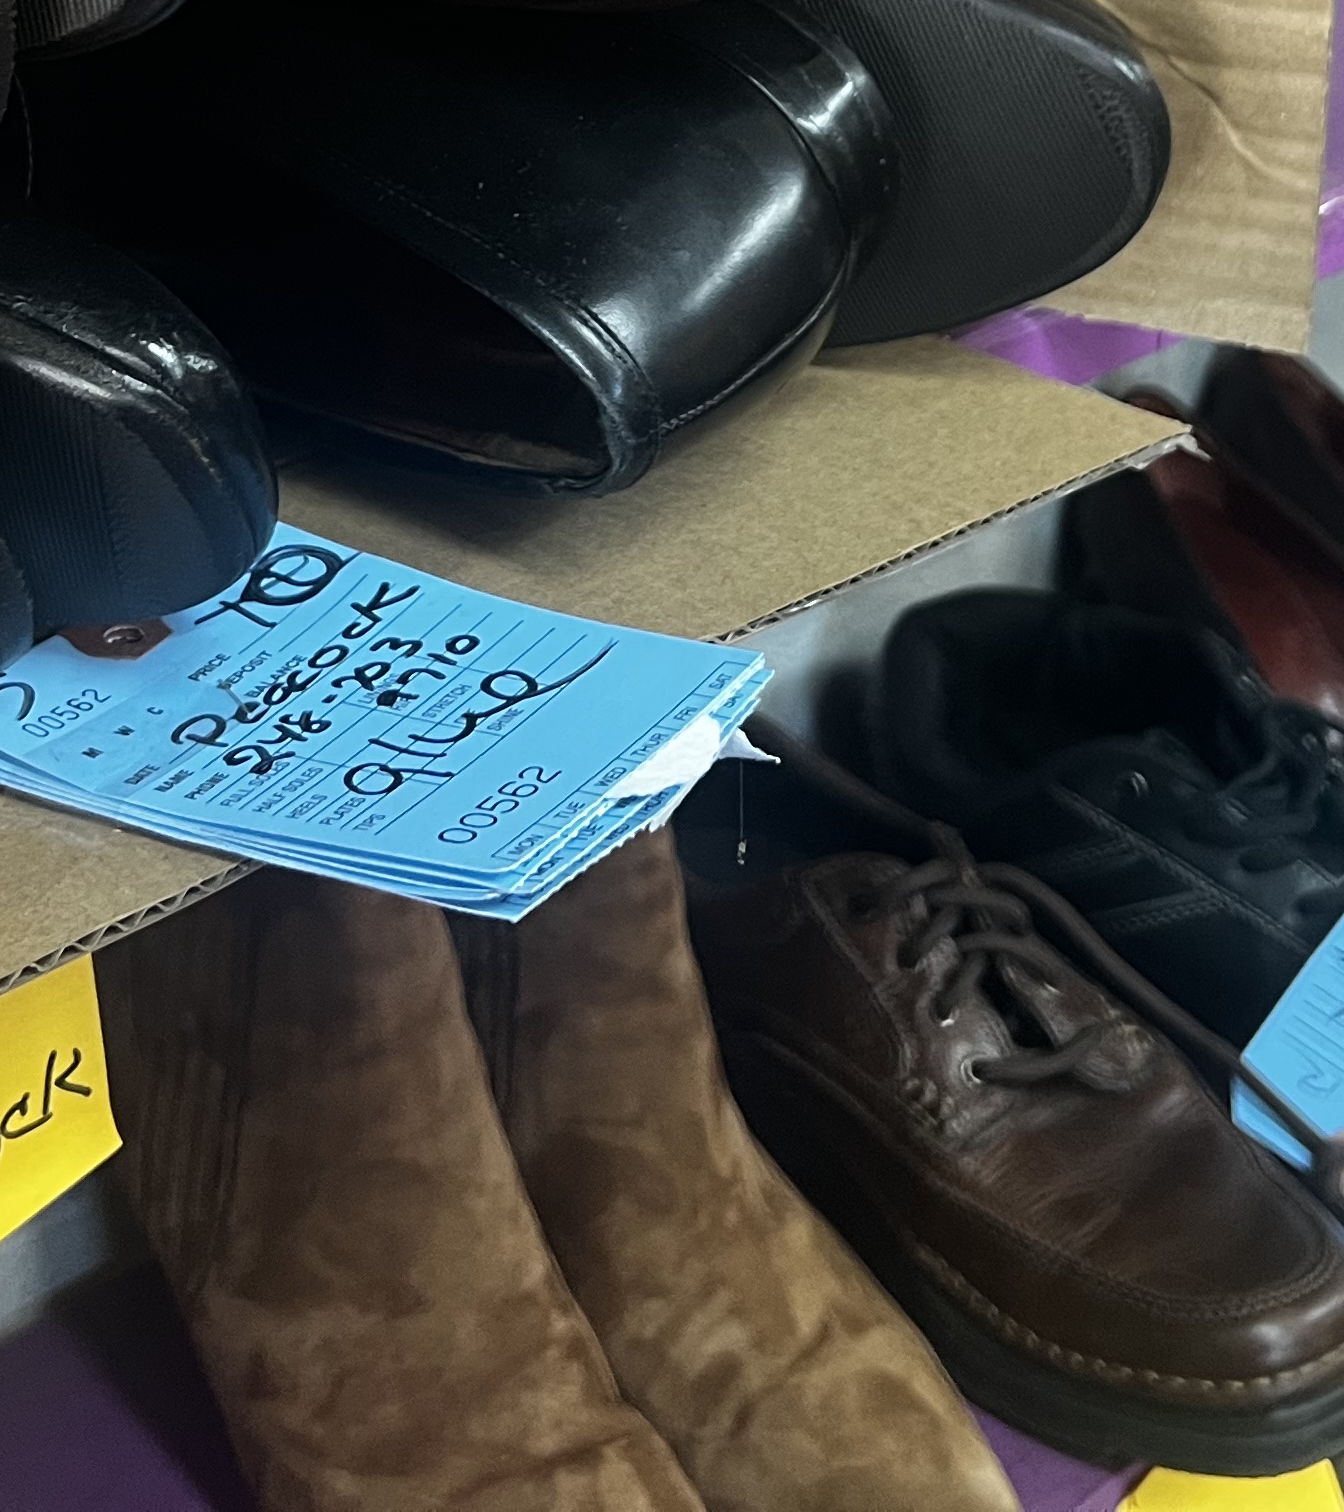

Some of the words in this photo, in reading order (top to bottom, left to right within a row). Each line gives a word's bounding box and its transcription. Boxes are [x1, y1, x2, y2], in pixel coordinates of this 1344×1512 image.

[170, 581, 423, 748] Peacock
[187, 651, 233, 683] PRICE
[21, 688, 113, 738] 00562
[421, 683, 474, 719] STRETCH
[123, 763, 162, 785] DATE
[507, 832, 545, 857] MON
[552, 801, 587, 820] TUE
[593, 766, 628, 788] WED
[629, 732, 672, 759] THUR
[672, 705, 699, 722] FRI
[708, 672, 734, 690] SAT
[153, 769, 195, 793] NAME
[183, 771, 231, 801] PHONE
[318, 795, 368, 827] PLATES
[437, 765, 563, 845] 00562
[352, 812, 387, 832] TIPS
